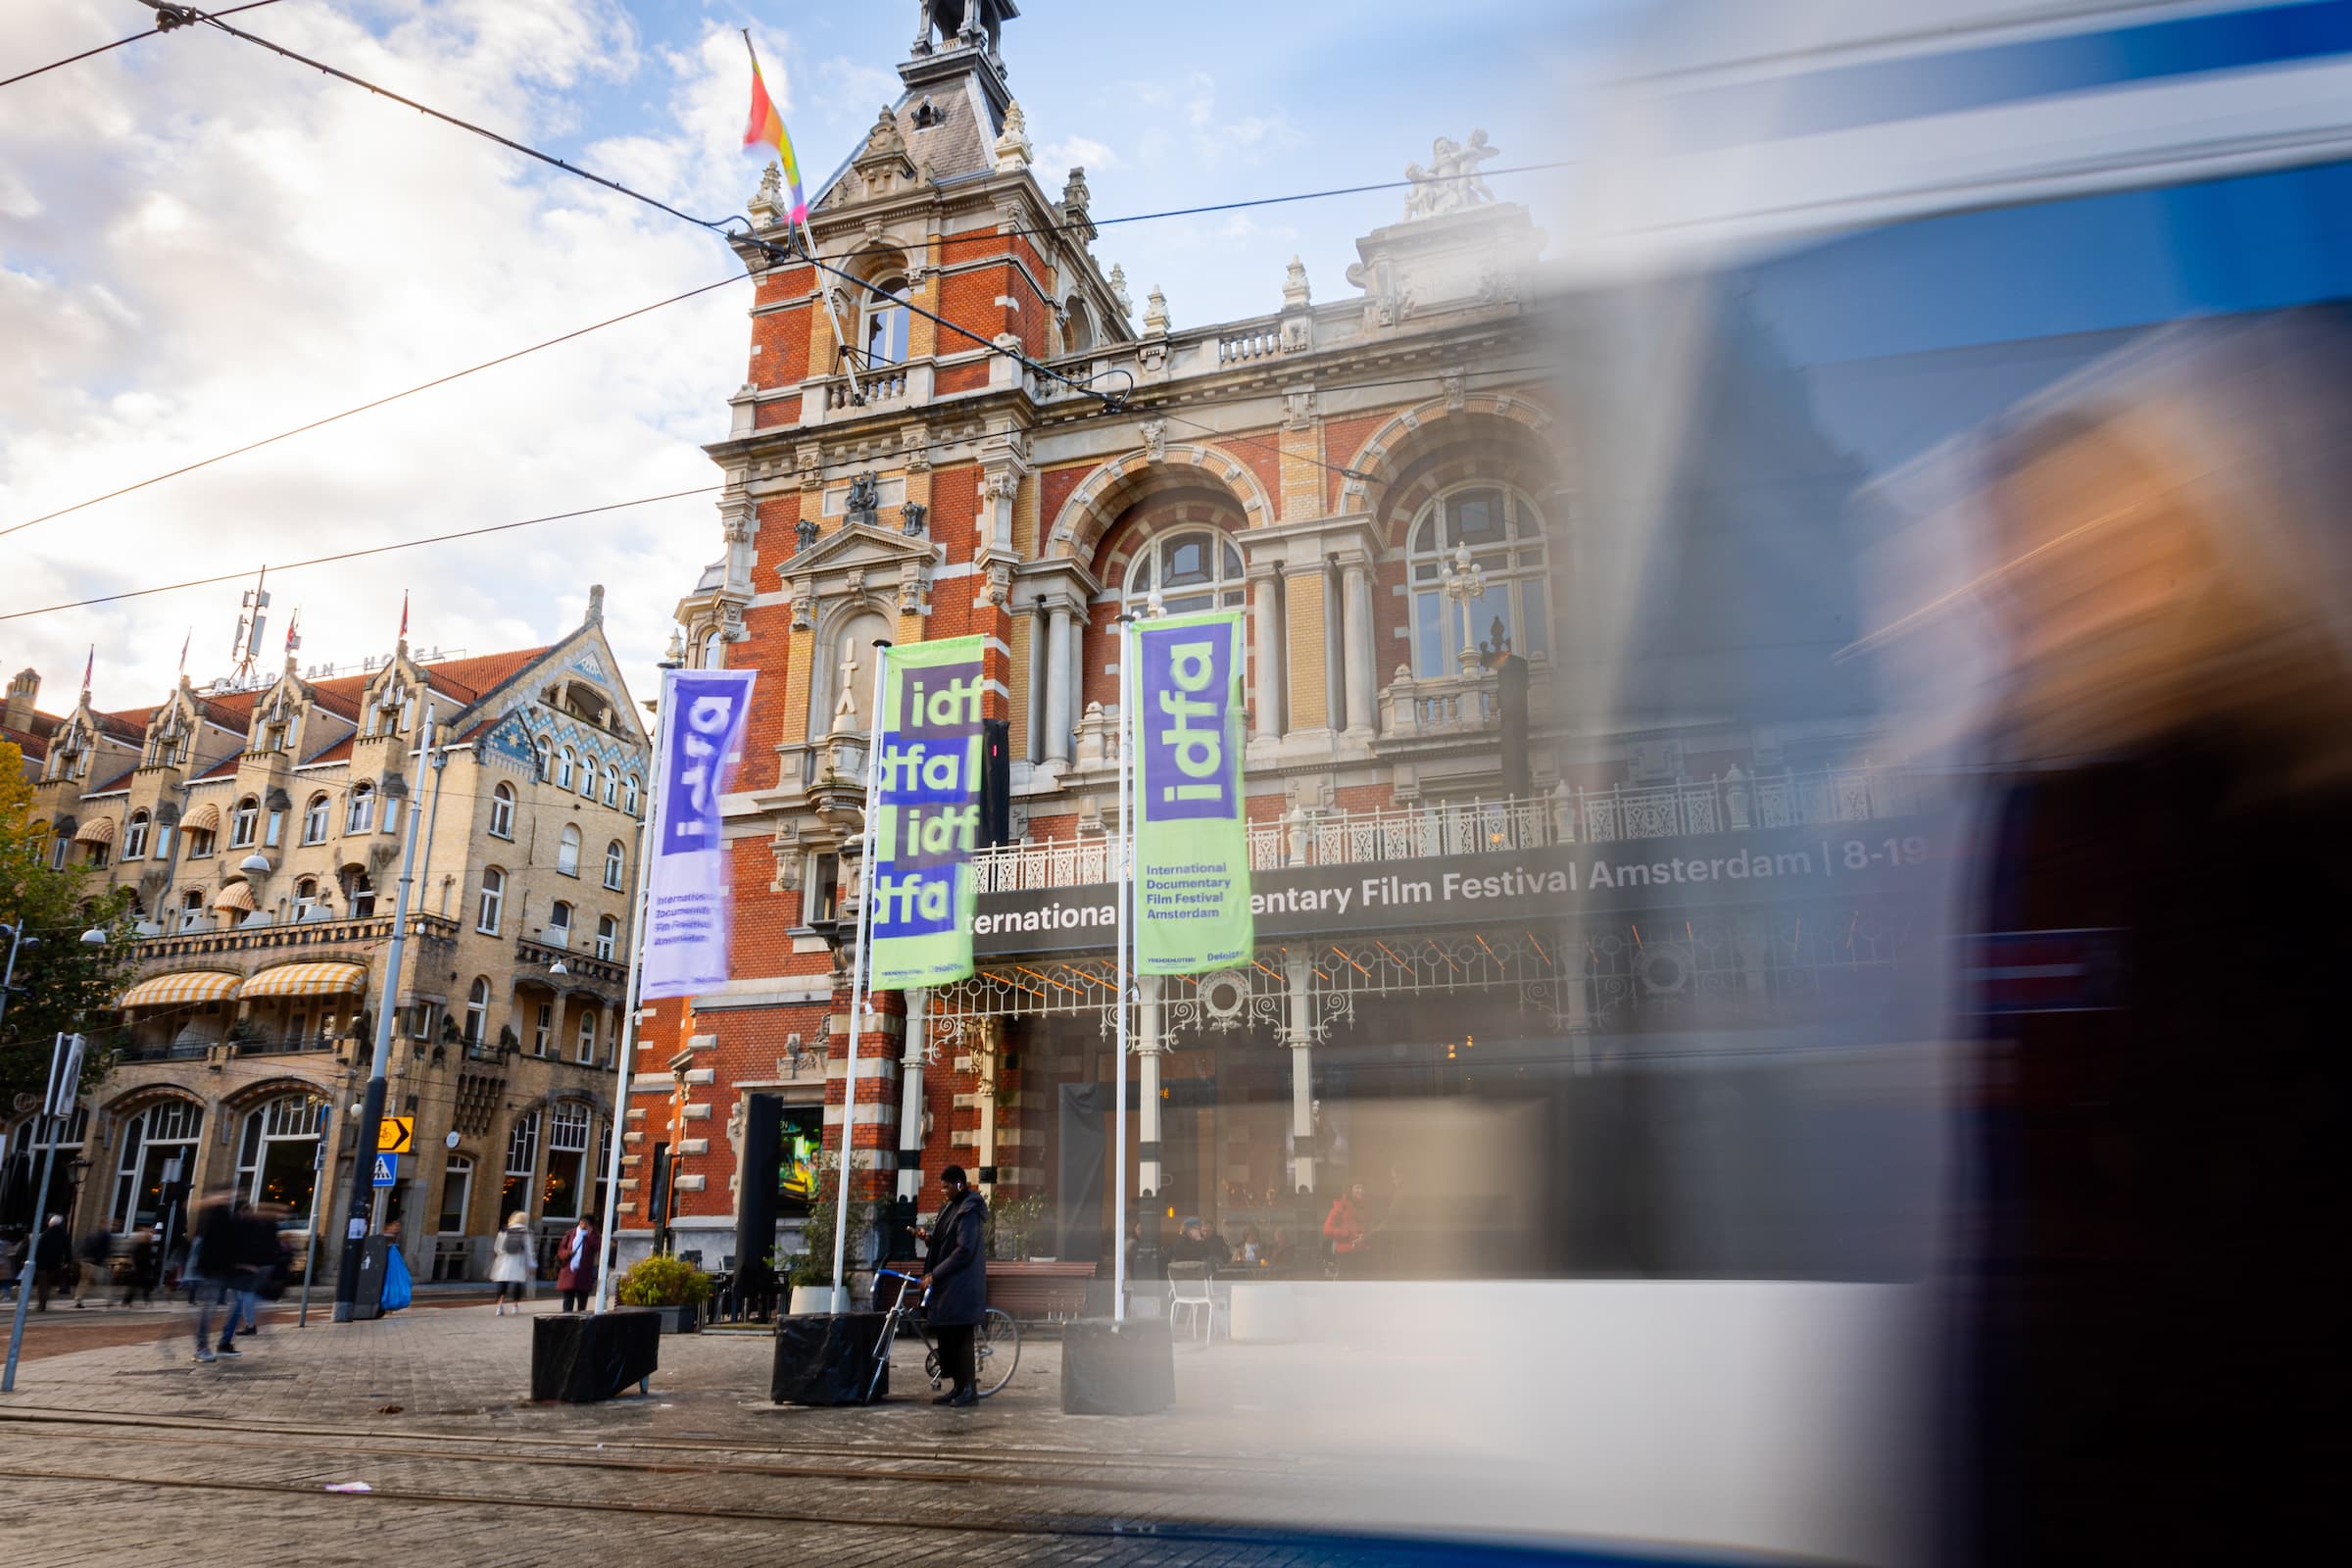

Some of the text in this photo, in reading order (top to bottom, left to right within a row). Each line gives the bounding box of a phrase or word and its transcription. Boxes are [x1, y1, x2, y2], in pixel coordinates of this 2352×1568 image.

[364, 646, 446, 670] HOEL
[910, 674, 984, 728] idf
[1159, 642, 1223, 803] idfa
[879, 743, 959, 793] dfa
[906, 804, 980, 858] idf
[965, 903, 1116, 934] ternationa
[1250, 882, 1352, 913] entary
[1362, 877, 1433, 906] Film
[1443, 862, 1577, 901] Festival
[1588, 849, 1811, 890] Amsterdam
[1842, 836, 1927, 870] 8-19
[1147, 861, 1227, 875] International
[1147, 878, 1231, 890] Documentary
[873, 873, 949, 924] dfa
[1147, 892, 1223, 904] Film Festival
[1147, 907, 1220, 919] Amsterdam
